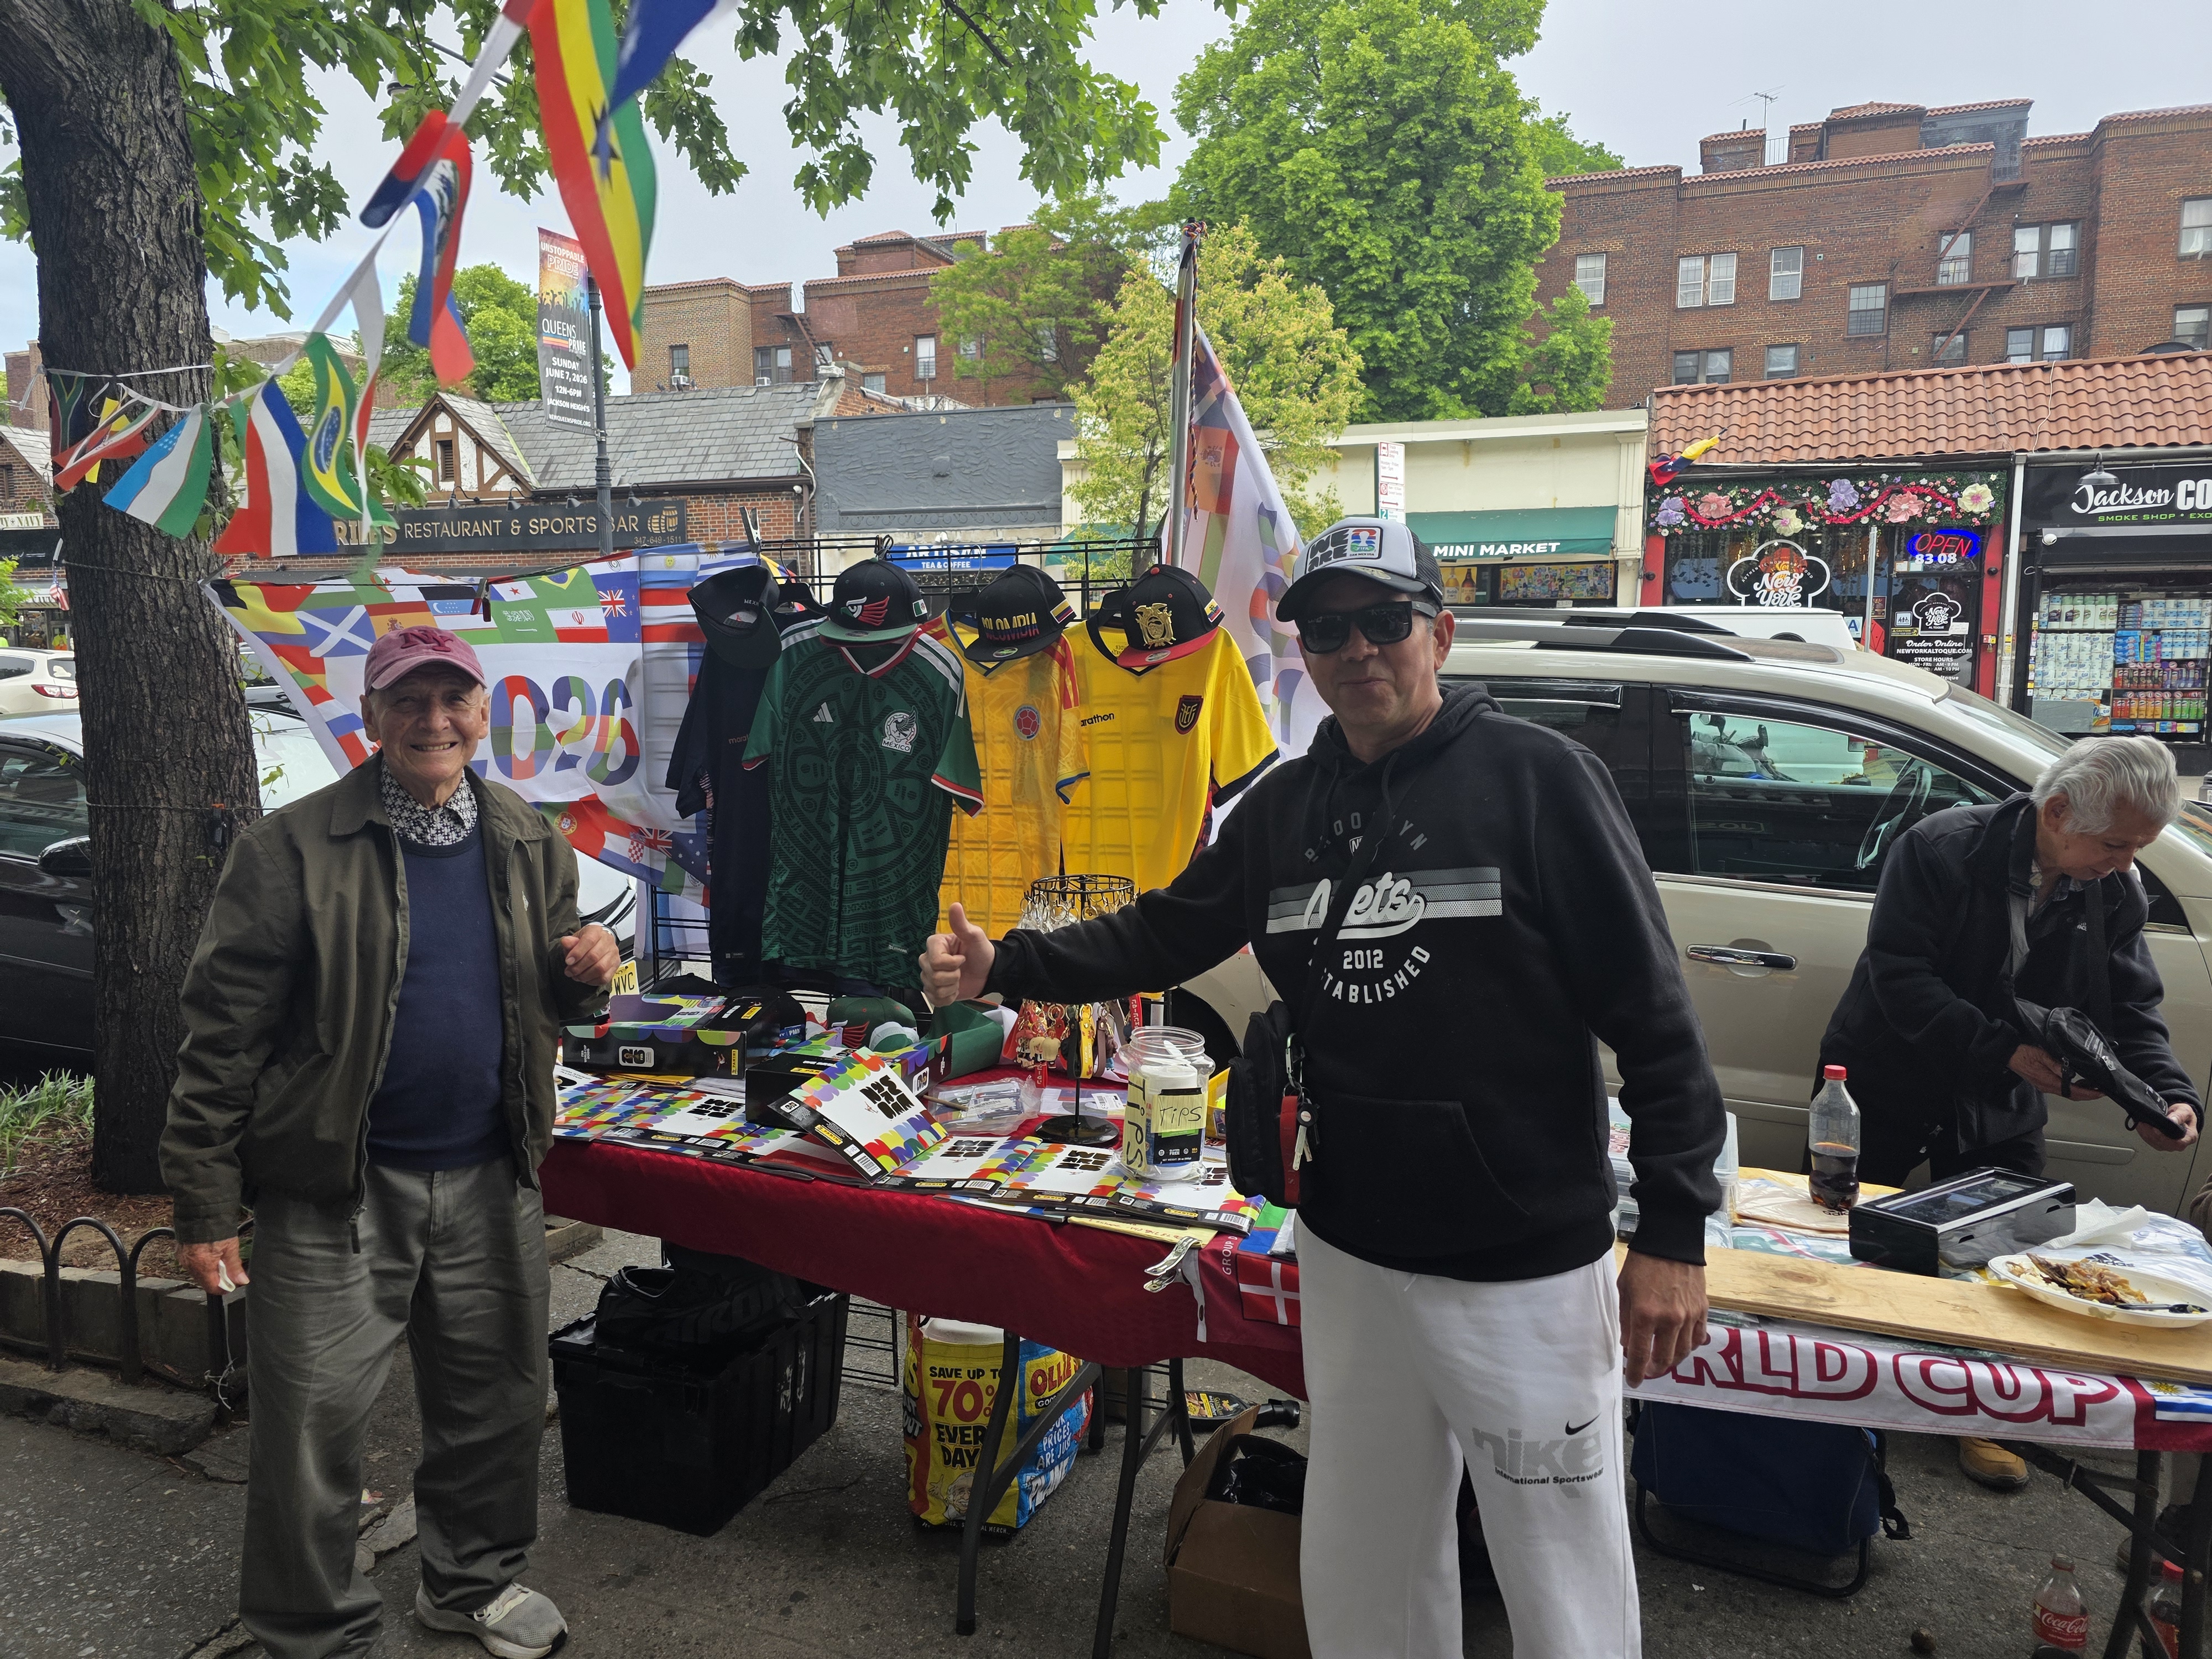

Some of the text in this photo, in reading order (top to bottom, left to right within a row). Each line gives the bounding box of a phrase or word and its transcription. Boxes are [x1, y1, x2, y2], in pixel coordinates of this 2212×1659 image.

[541, 242, 584, 264] UNSTOPPABLE
[547, 254, 578, 276] PRIDE
[542, 319, 576, 339] QUEENS
[552, 357, 580, 371] SUNDAY
[546, 367, 587, 384] JUNE 7, 2026
[555, 385, 582, 398] 12N-6PM
[547, 398, 570, 409] JACKSON
[2072, 483, 2174, 514] Jackson
[17, 515, 41, 527] NAVY
[1382, 510, 1387, 520] 2
[404, 519, 502, 539] RESTAURANT
[510, 519, 521, 535] &
[529, 515, 597, 535] SPORTS
[634, 536, 682, 545] 347-649-1511
[1310, 529, 1350, 559] WE
[1433, 542, 1561, 557] MINI MARKET
[1916, 534, 1972, 557] OPEN
[906, 545, 987, 560] ARTISAN
[1308, 544, 1348, 572] ARE
[1753, 570, 1804, 591] New
[1755, 585, 1803, 608] York
[1925, 606, 1950, 617] New
[1926, 613, 1948, 626] York
[1848, 619, 1859, 632] A
[399, 629, 453, 653] NY
[471, 675, 640, 787] 026
[882, 739, 911, 753] MÉXICO
[1343, 949, 1384, 969] 2012
[1319, 946, 1431, 1004] TABLISHED
[1222, 1240, 1235, 1275] GROUP
[929, 1365, 962, 1379] SAVE
[967, 1367, 985, 1380] UP
[1893, 1351, 2122, 1427] CUP
[935, 1422, 988, 1446] EVER
[1043, 1421, 1071, 1452] PRICES
[941, 1445, 981, 1469] DAY
[1036, 1448, 1055, 1470] ARE
[1472, 1427, 1603, 1499] nike
[1495, 1467, 1604, 1485] International Sportswear
